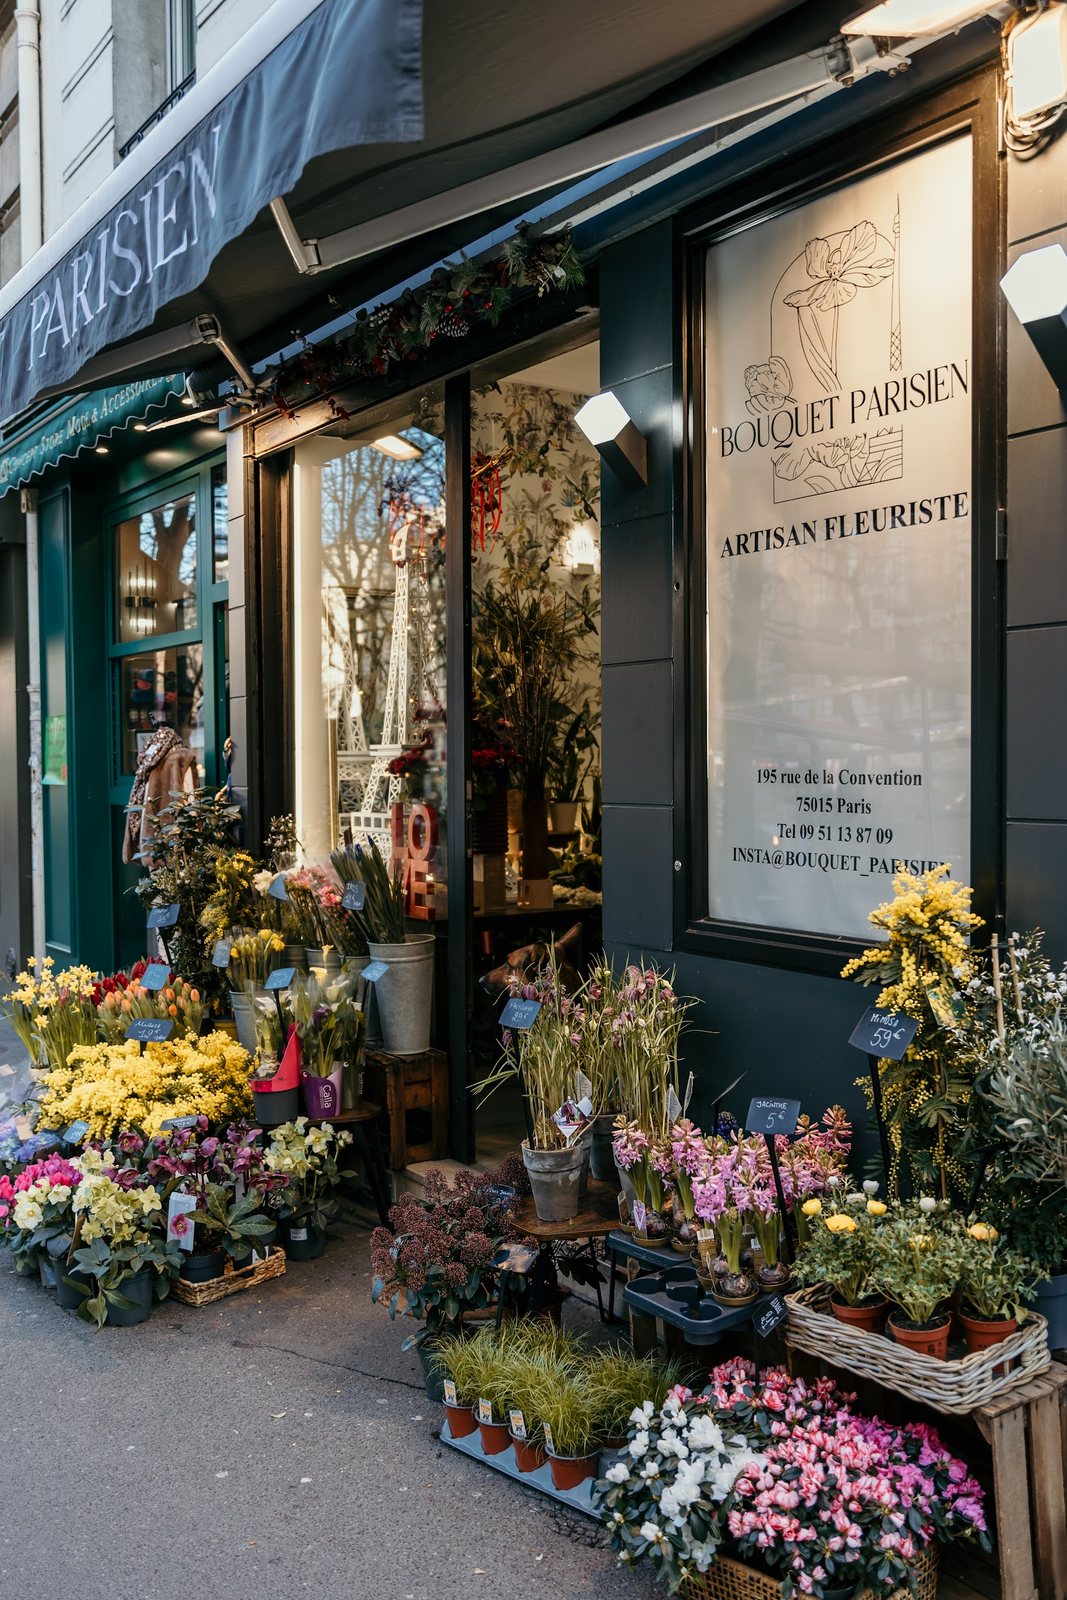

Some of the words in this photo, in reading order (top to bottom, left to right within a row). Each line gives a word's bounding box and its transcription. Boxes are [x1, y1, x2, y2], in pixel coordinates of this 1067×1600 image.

[28, 124, 222, 371] PARISIEN
[720, 396, 840, 457] BOUQUET
[850, 360, 969, 424] PARISIEN
[66, 414, 91, 440] MODE
[91, 408, 98, 424] &
[720, 520, 817, 558] ARTISAN
[824, 492, 969, 541] FLEURISTE
[756, 769, 777, 784] 195
[780, 772, 801, 784] rue
[804, 769, 819, 784] de
[822, 769, 834, 785] la
[838, 769, 923, 786] Convention
[796, 796, 833, 813] 75015
[837, 798, 872, 814] Paris
[777, 823, 796, 839] Tel
[800, 824, 814, 840] 09
[818, 825, 832, 841] 51
[837, 826, 852, 842] 13
[856, 827, 872, 844] 87
[876, 828, 893, 845] 09
[322, 1084, 333, 1109] Calla
